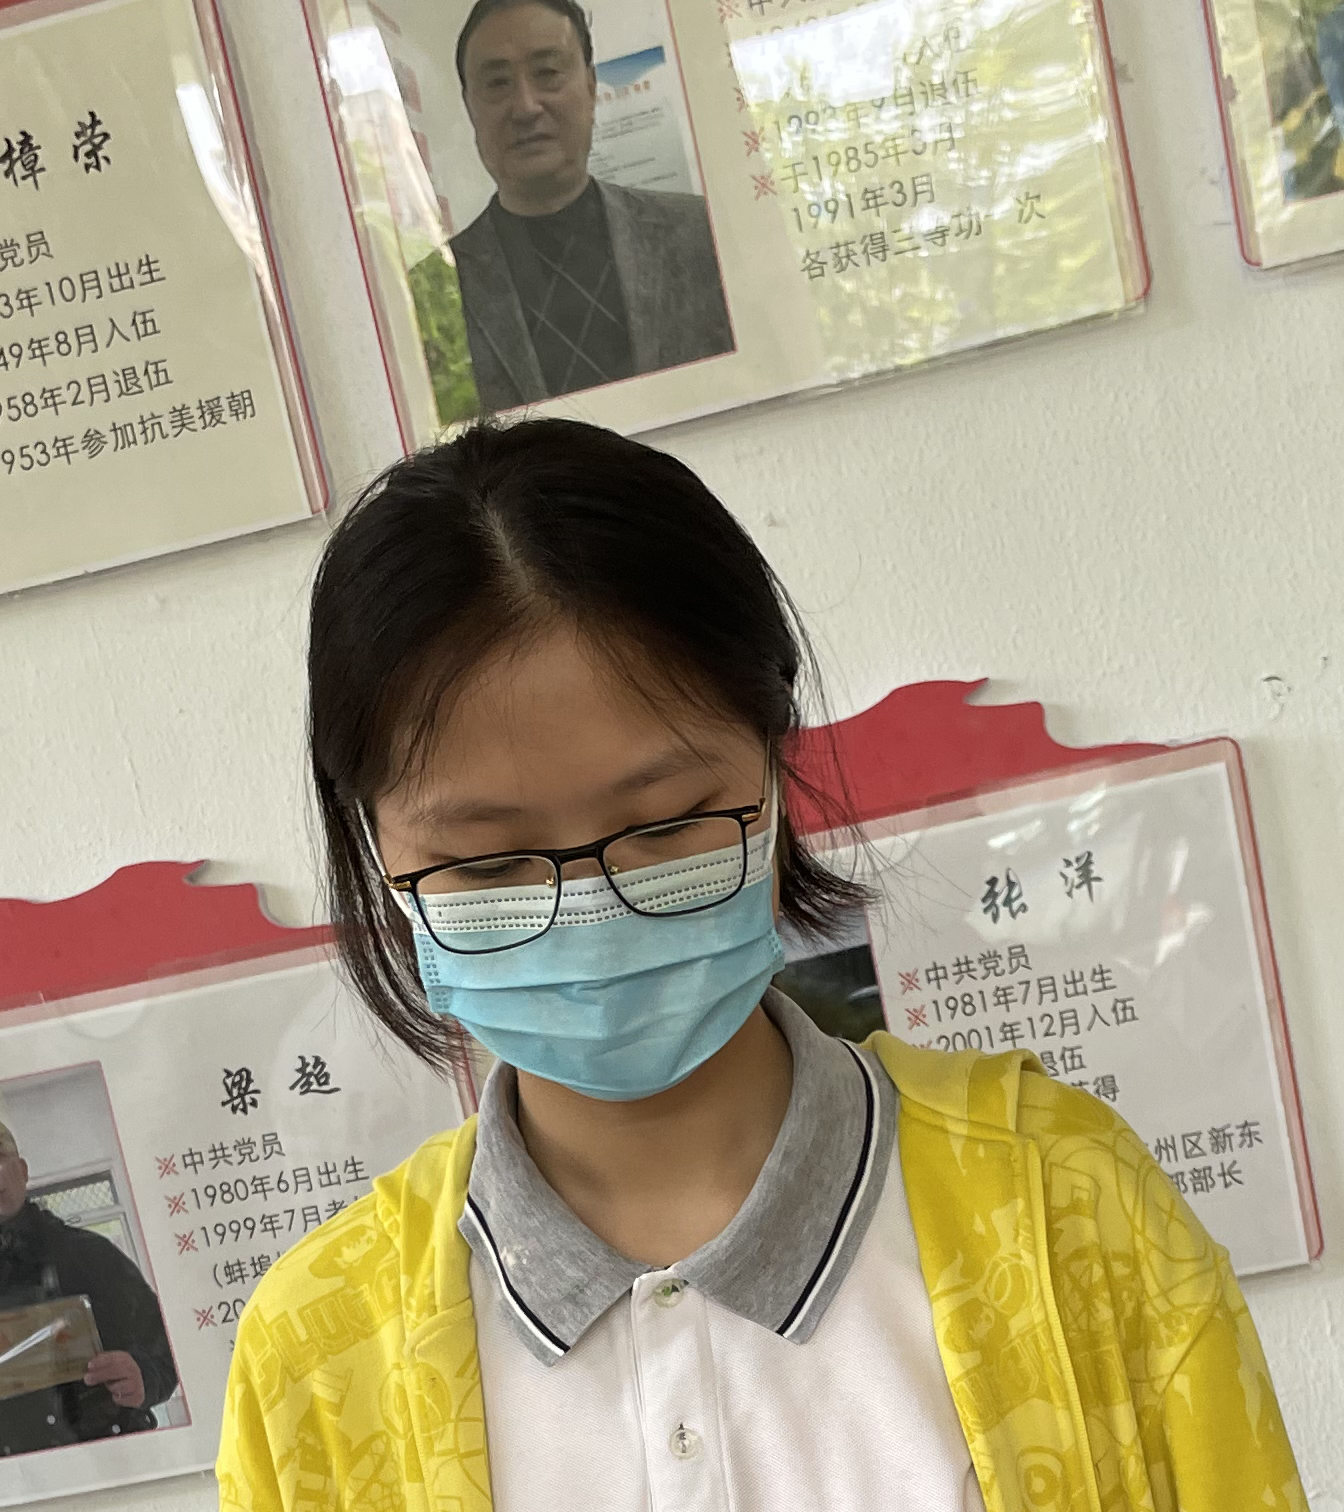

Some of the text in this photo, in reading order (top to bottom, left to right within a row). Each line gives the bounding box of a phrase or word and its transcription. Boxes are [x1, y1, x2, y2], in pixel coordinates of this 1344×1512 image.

[793, 173, 937, 233] 1991年3月
[924, 944, 1033, 993] 中共党员
[931, 963, 1118, 1025] 1981年7月出生
[936, 996, 1140, 1053] 2001年12月入伍
[221, 1056, 342, 1113] 梁超
[182, 1132, 286, 1175] 中共党员
[1144, 1119, 1264, 1165] 州区新东
[191, 1157, 370, 1210] 1980年6月出生
